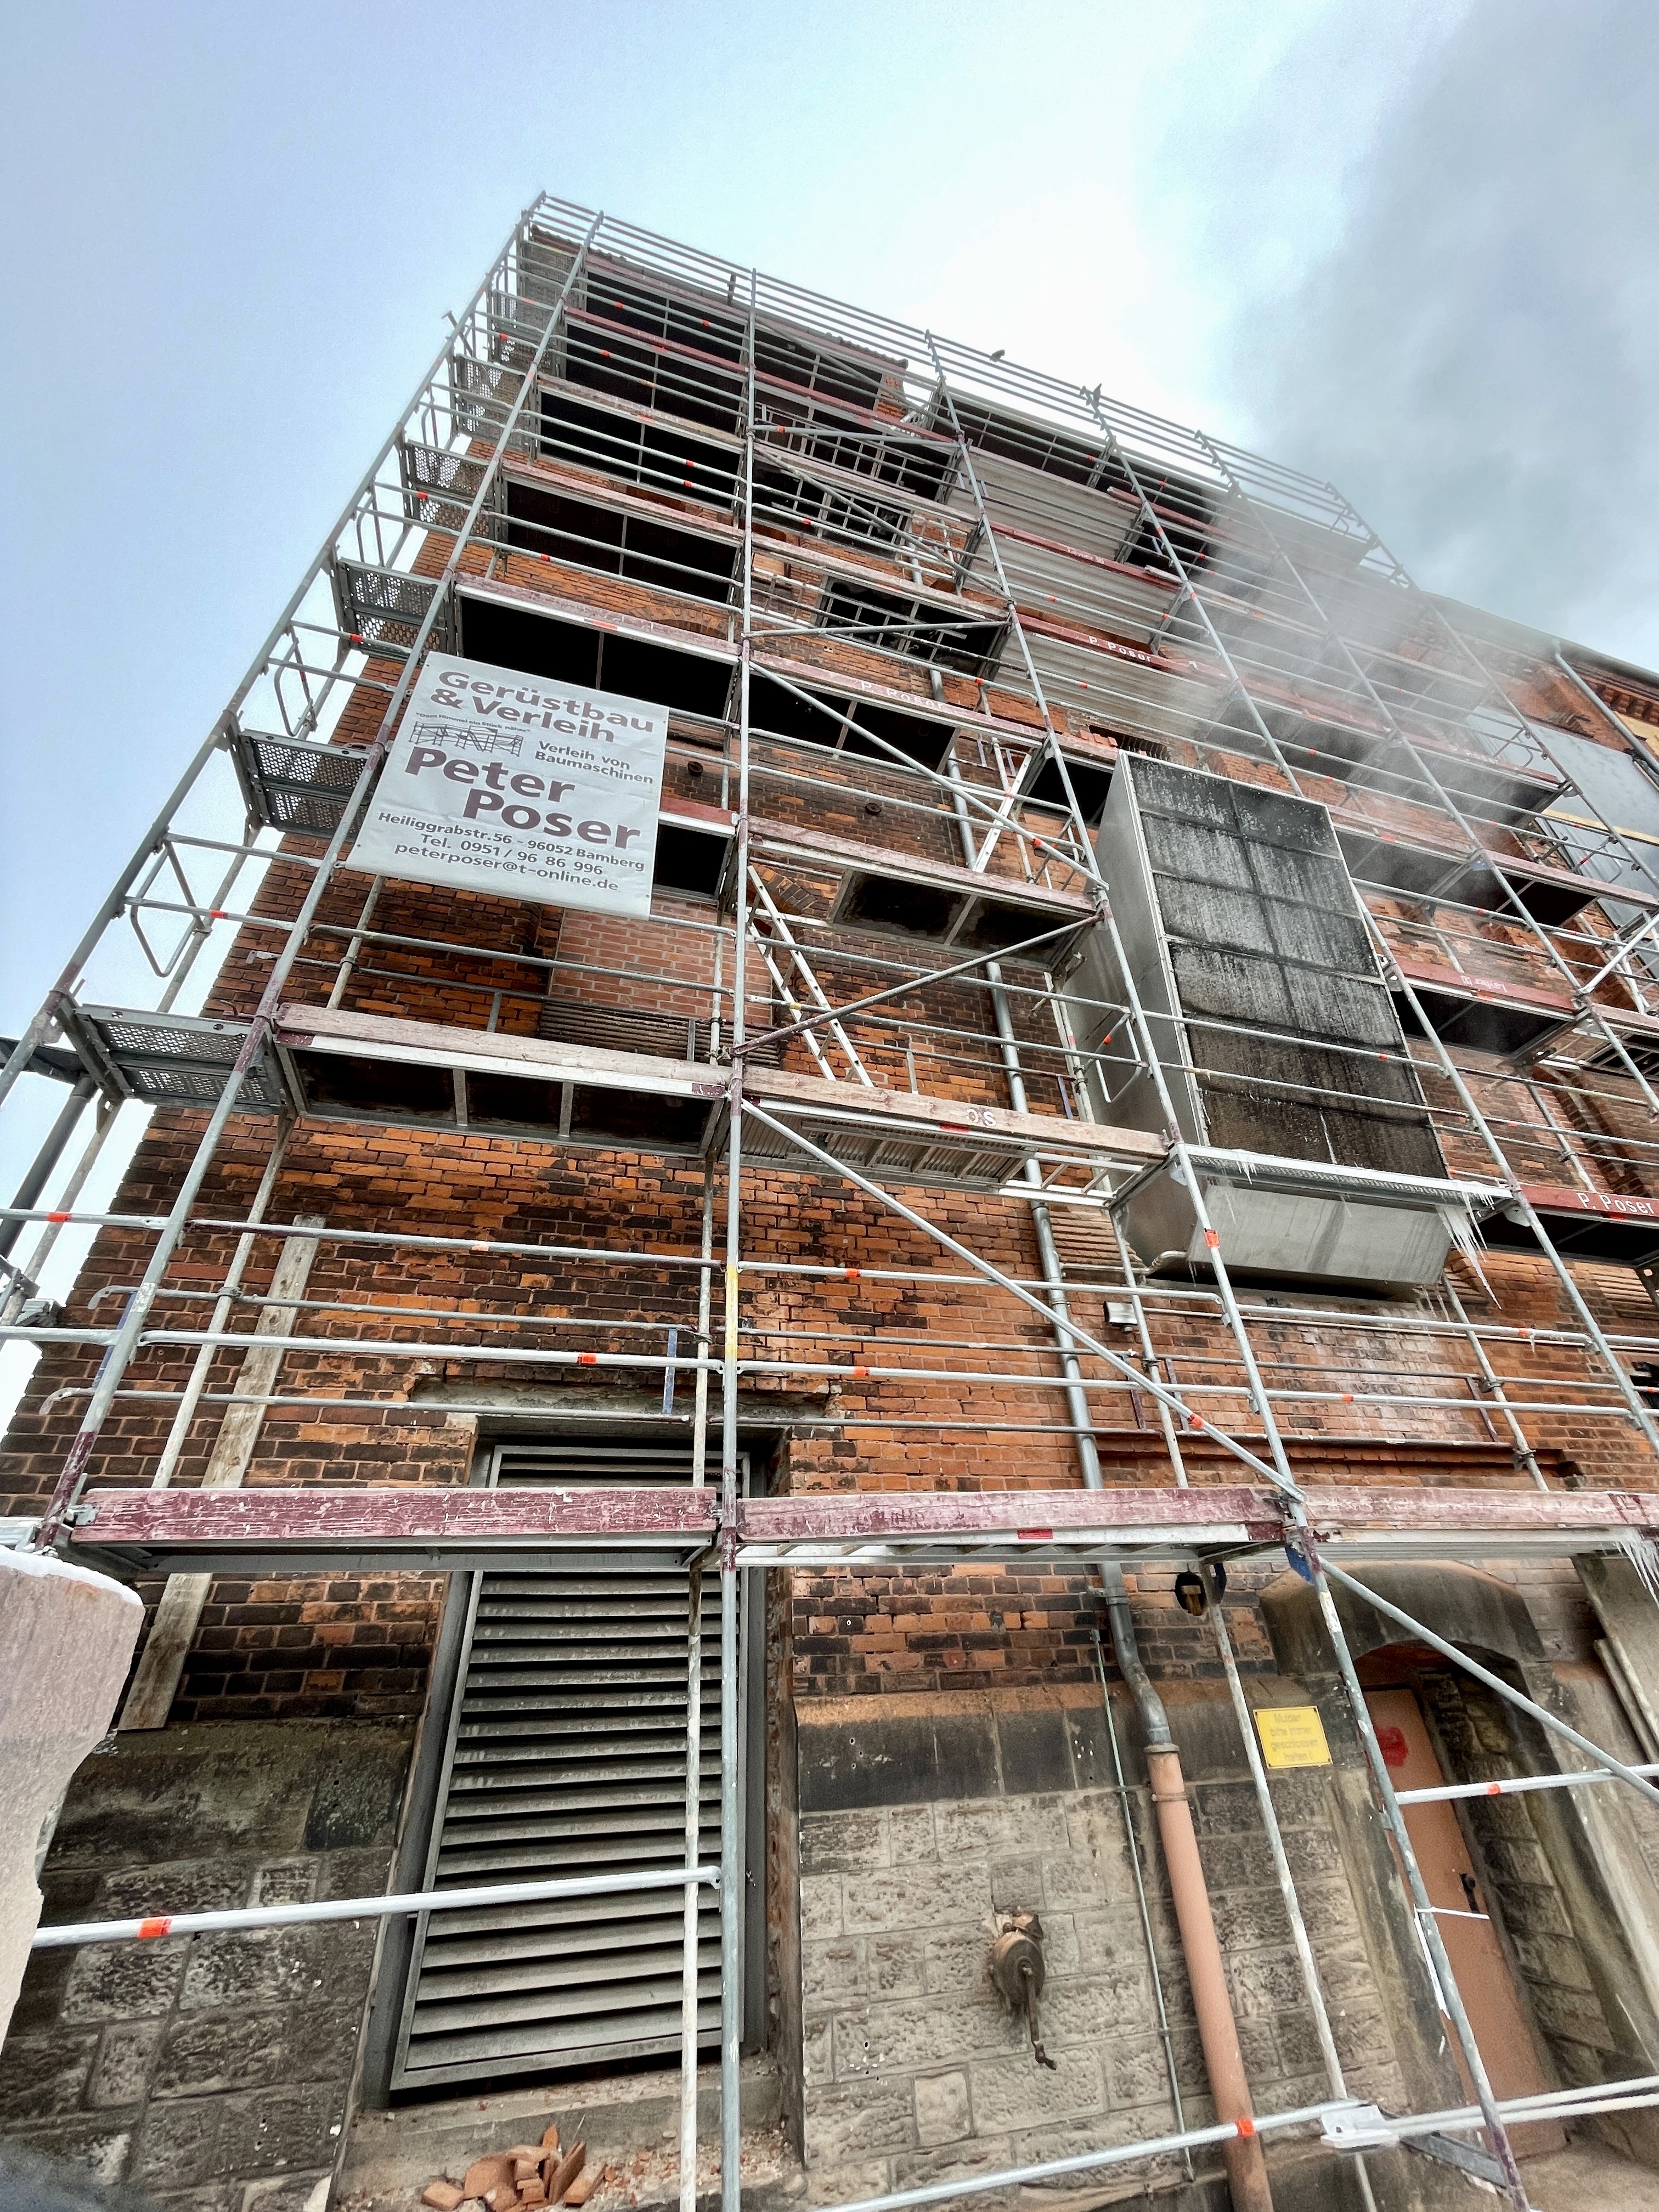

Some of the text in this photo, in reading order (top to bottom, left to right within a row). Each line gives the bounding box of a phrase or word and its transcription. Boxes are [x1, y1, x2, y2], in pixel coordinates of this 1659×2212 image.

[430, 689, 615, 743] & Verleih
[439, 671, 654, 732] Gerüstbau
[439, 714, 467, 723] Himmel
[405, 746, 575, 803] Peter
[535, 751, 653, 785] Baumaschinen
[539, 741, 630, 770] Verleih von
[463, 788, 641, 849] Poser
[395, 844, 619, 890] peterposer@t-online.de
[421, 834, 451, 849] Tel.
[517, 851, 538, 863] 96
[545, 857, 566, 868] 86
[574, 861, 603, 875] 996
[528, 840, 573, 855] 96052
[576, 849, 644, 872] Bamberg
[1576, 1192, 1655, 1214] P. Poser
